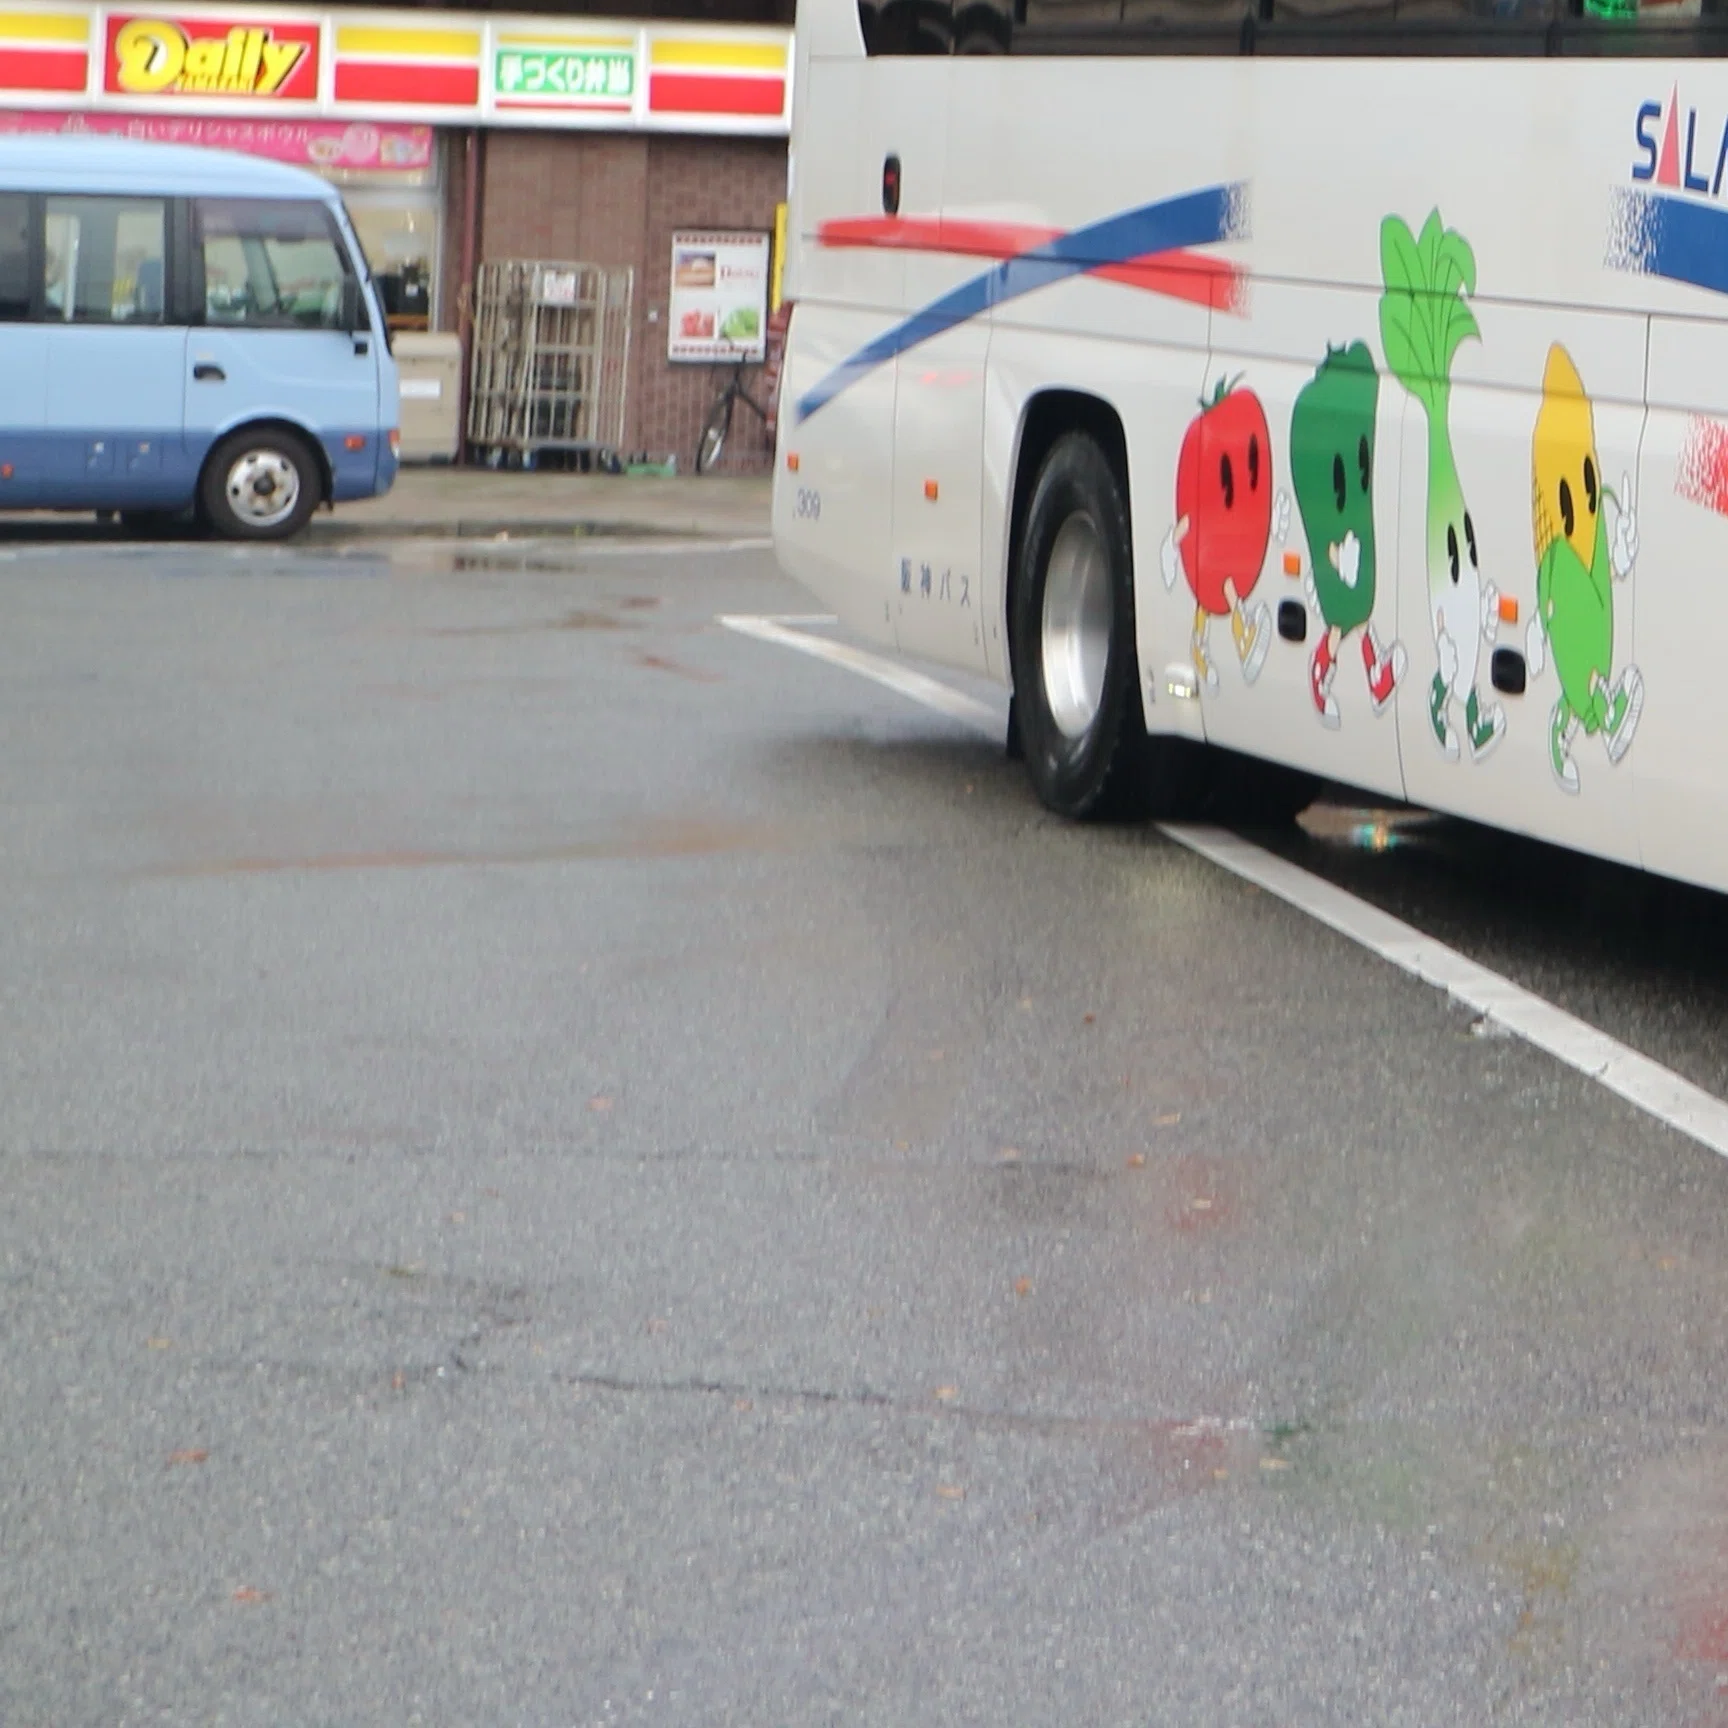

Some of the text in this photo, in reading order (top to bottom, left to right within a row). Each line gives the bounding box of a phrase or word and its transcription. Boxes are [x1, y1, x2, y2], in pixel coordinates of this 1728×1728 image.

[114, 17, 308, 95] Daily
[797, 488, 821, 520] 309
[900, 557, 970, 608] 阪神バス
